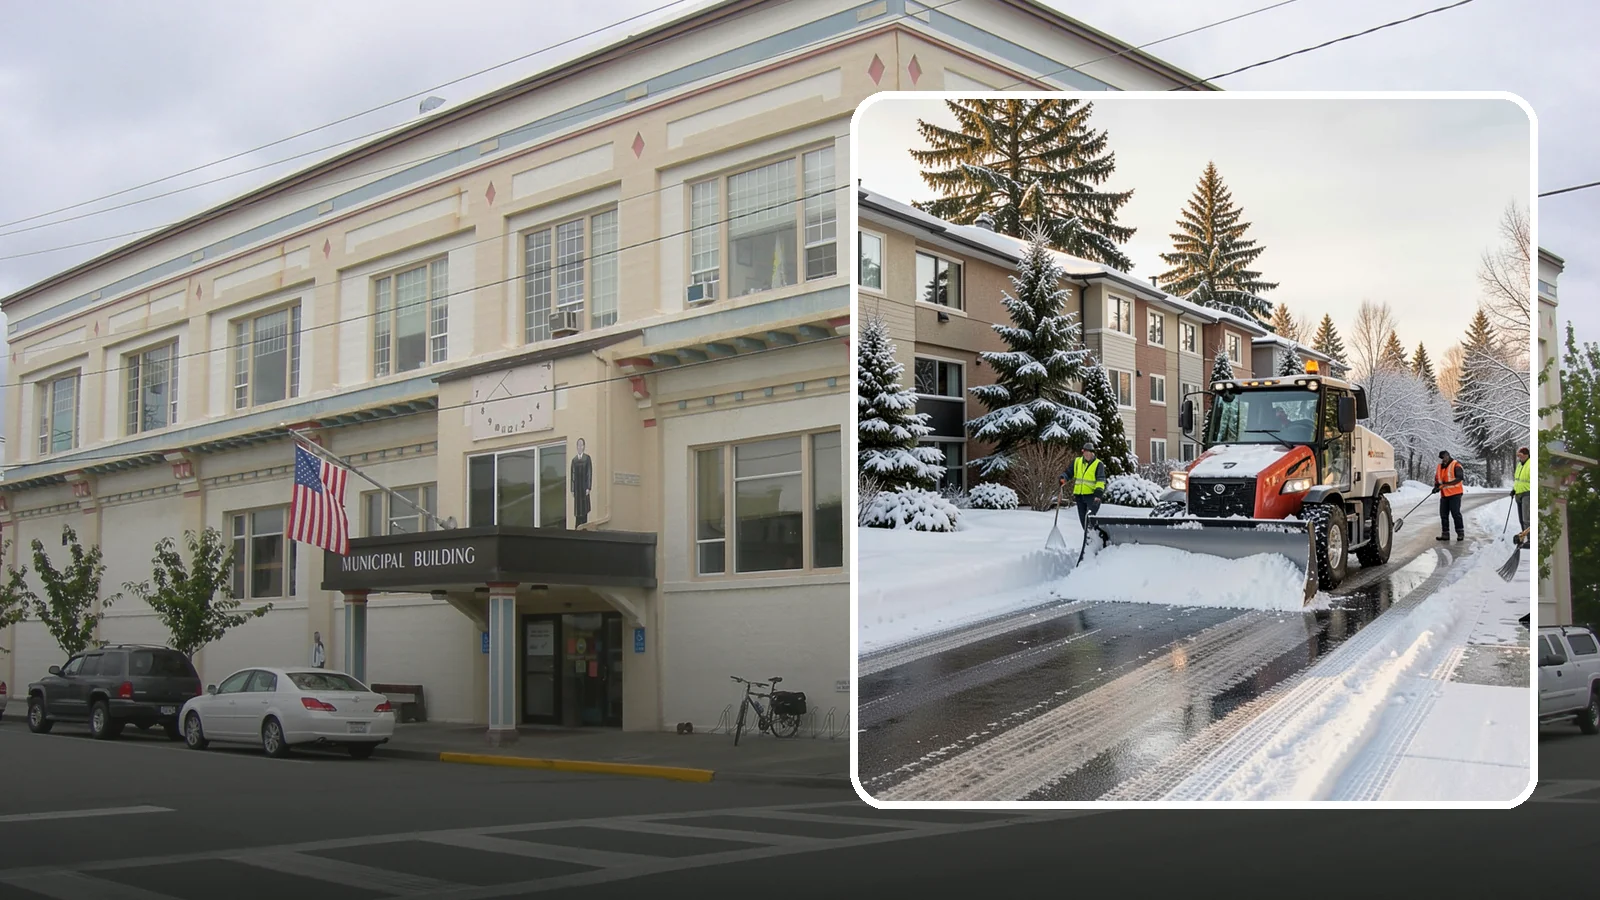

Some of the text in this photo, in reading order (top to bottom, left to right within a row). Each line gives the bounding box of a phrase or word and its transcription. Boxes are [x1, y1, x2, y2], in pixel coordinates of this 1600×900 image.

[536, 402, 540, 410] 4
[480, 407, 485, 415] 8
[487, 417, 492, 426] 9
[529, 414, 533, 422] 3
[494, 423, 500, 432] 10
[521, 420, 525, 428] 2
[507, 425, 513, 433] 12
[342, 546, 475, 572] MUNICIPAL BUILDING
